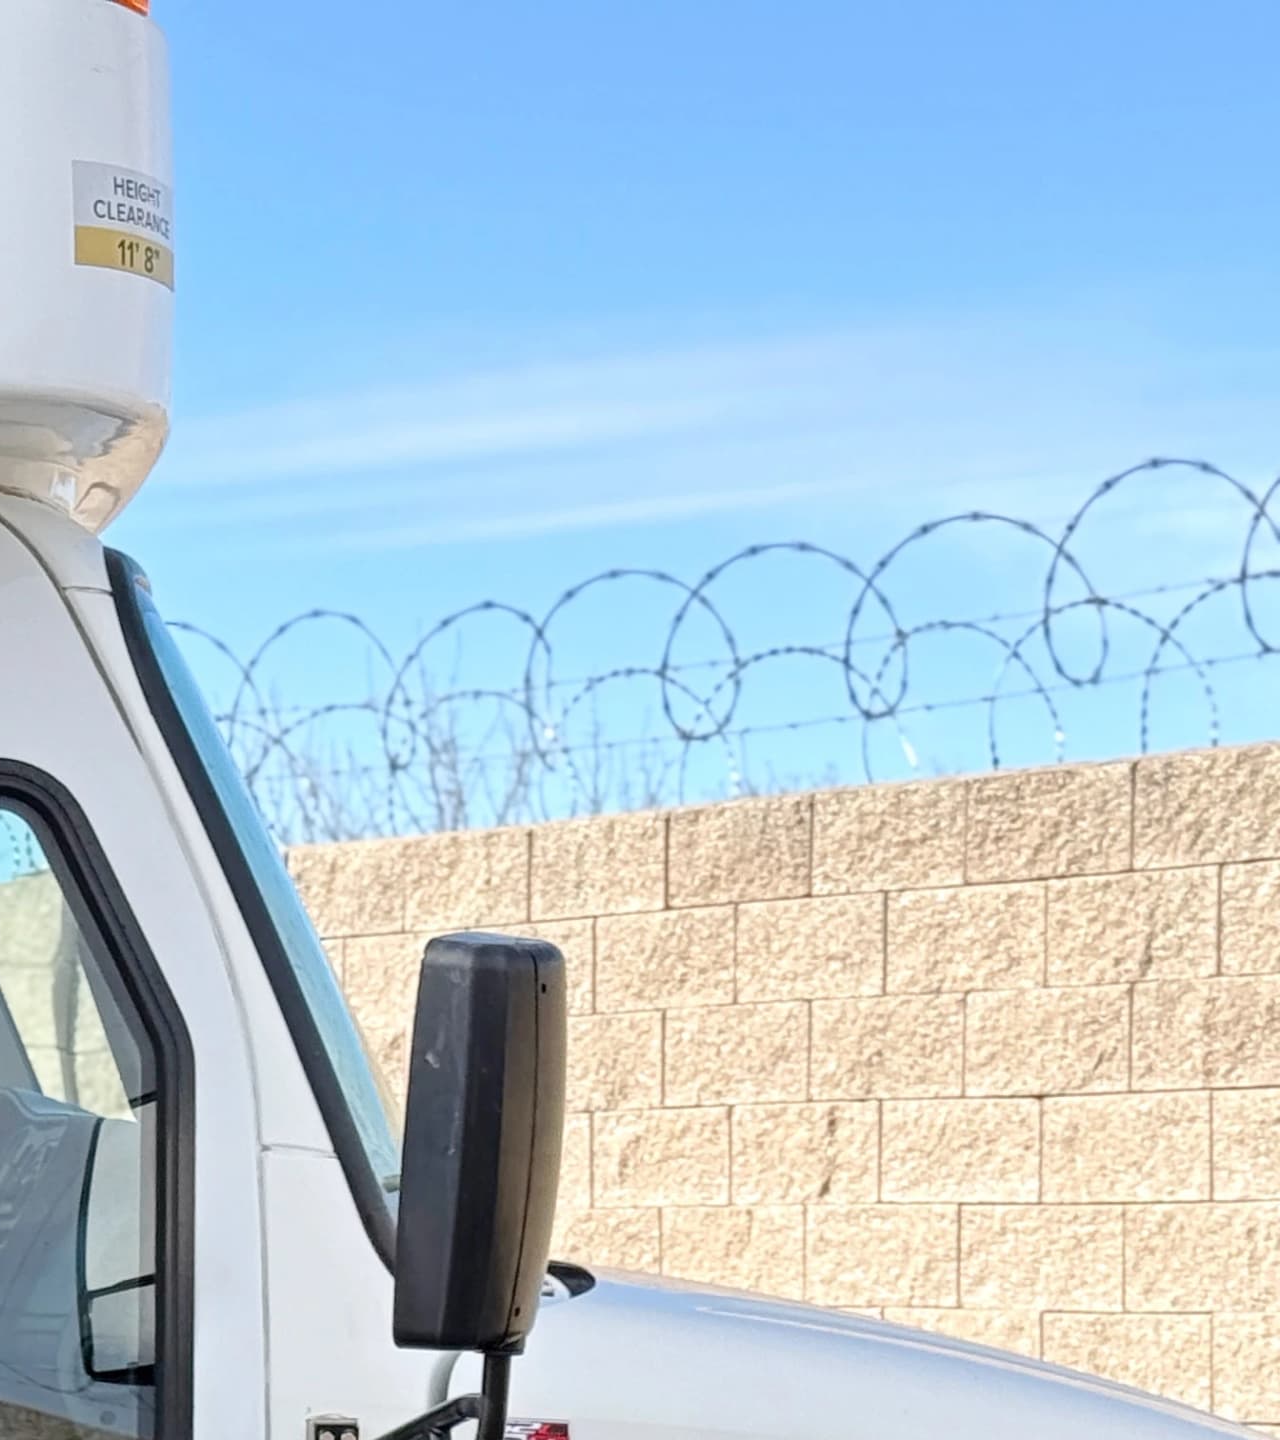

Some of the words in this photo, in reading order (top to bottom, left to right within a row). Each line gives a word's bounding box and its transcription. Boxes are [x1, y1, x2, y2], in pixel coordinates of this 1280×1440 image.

[112, 175, 161, 209] HEIGHT
[92, 198, 171, 241] CLEARANCE
[117, 239, 140, 269] 11'
